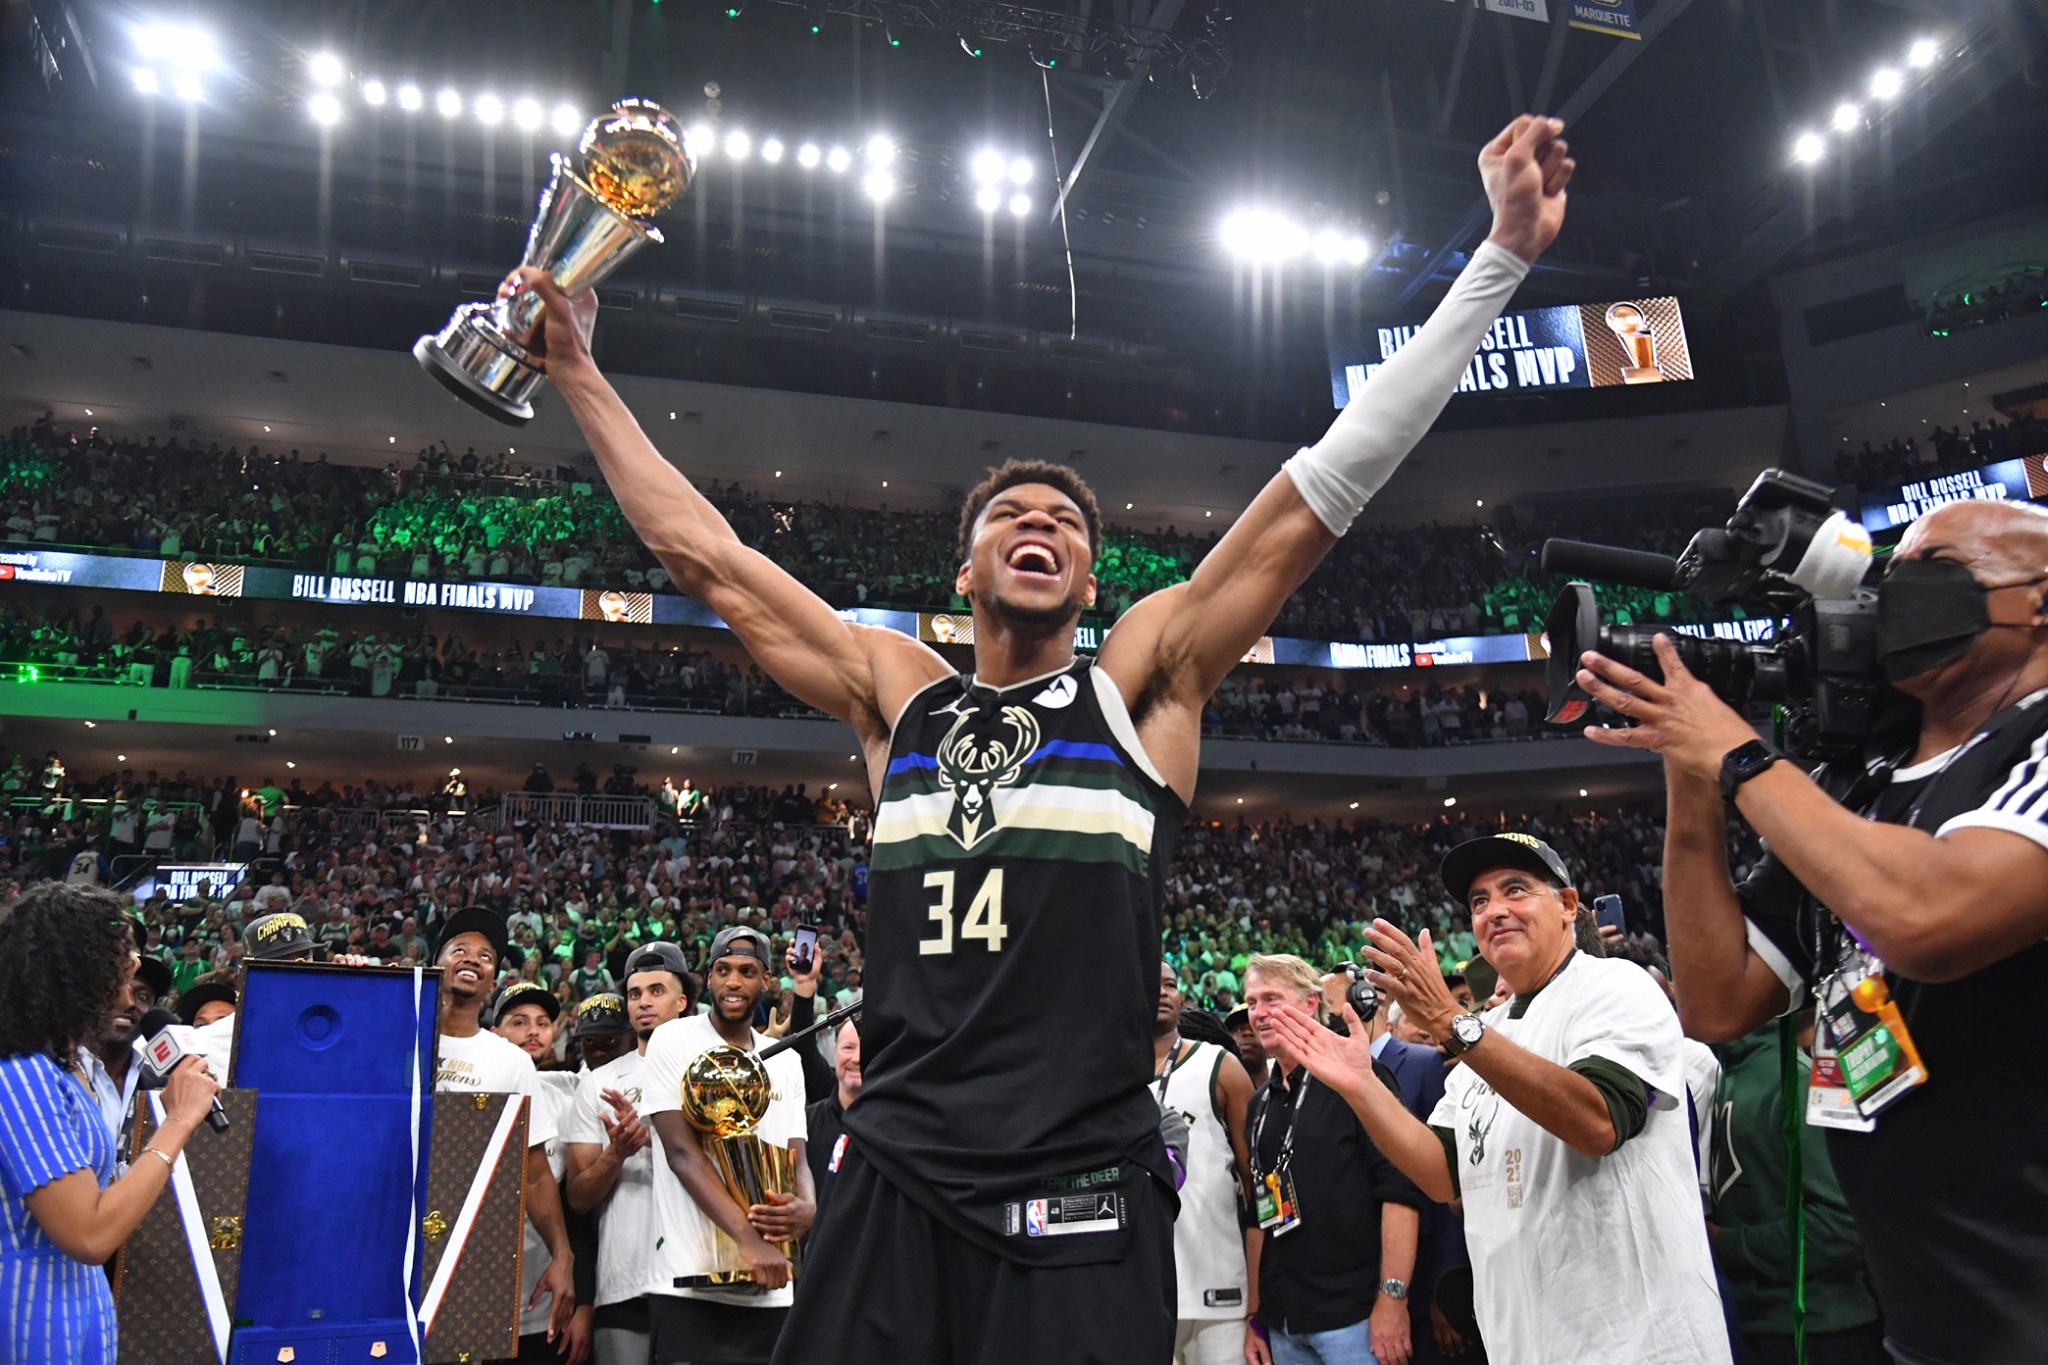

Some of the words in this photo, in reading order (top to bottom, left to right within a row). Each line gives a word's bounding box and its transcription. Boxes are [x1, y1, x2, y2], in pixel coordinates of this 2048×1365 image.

[1574, 5, 1632, 27] MARQUETTE
[1514, 347, 1576, 387] MVP
[1902, 481, 1930, 502] BILL
[1929, 470, 1984, 497] RUSSELL
[1887, 499, 1919, 525] NBA
[292, 575, 326, 598] BILL
[330, 578, 395, 603] RUSSELL
[404, 581, 437, 605] NBA
[441, 584, 496, 609] FINALS
[499, 586, 535, 611] MVP
[1366, 643, 1411, 668] FINALS
[401, 737, 419, 749] 117
[74, 863, 90, 875] 34
[171, 871, 189, 885] BILL
[919, 868, 1008, 955] 34
[447, 1059, 475, 1073] NBA
[1505, 1148, 1522, 1165] 20
[1071, 1172, 1091, 1189] THE
[1091, 1167, 1120, 1185] DEER
